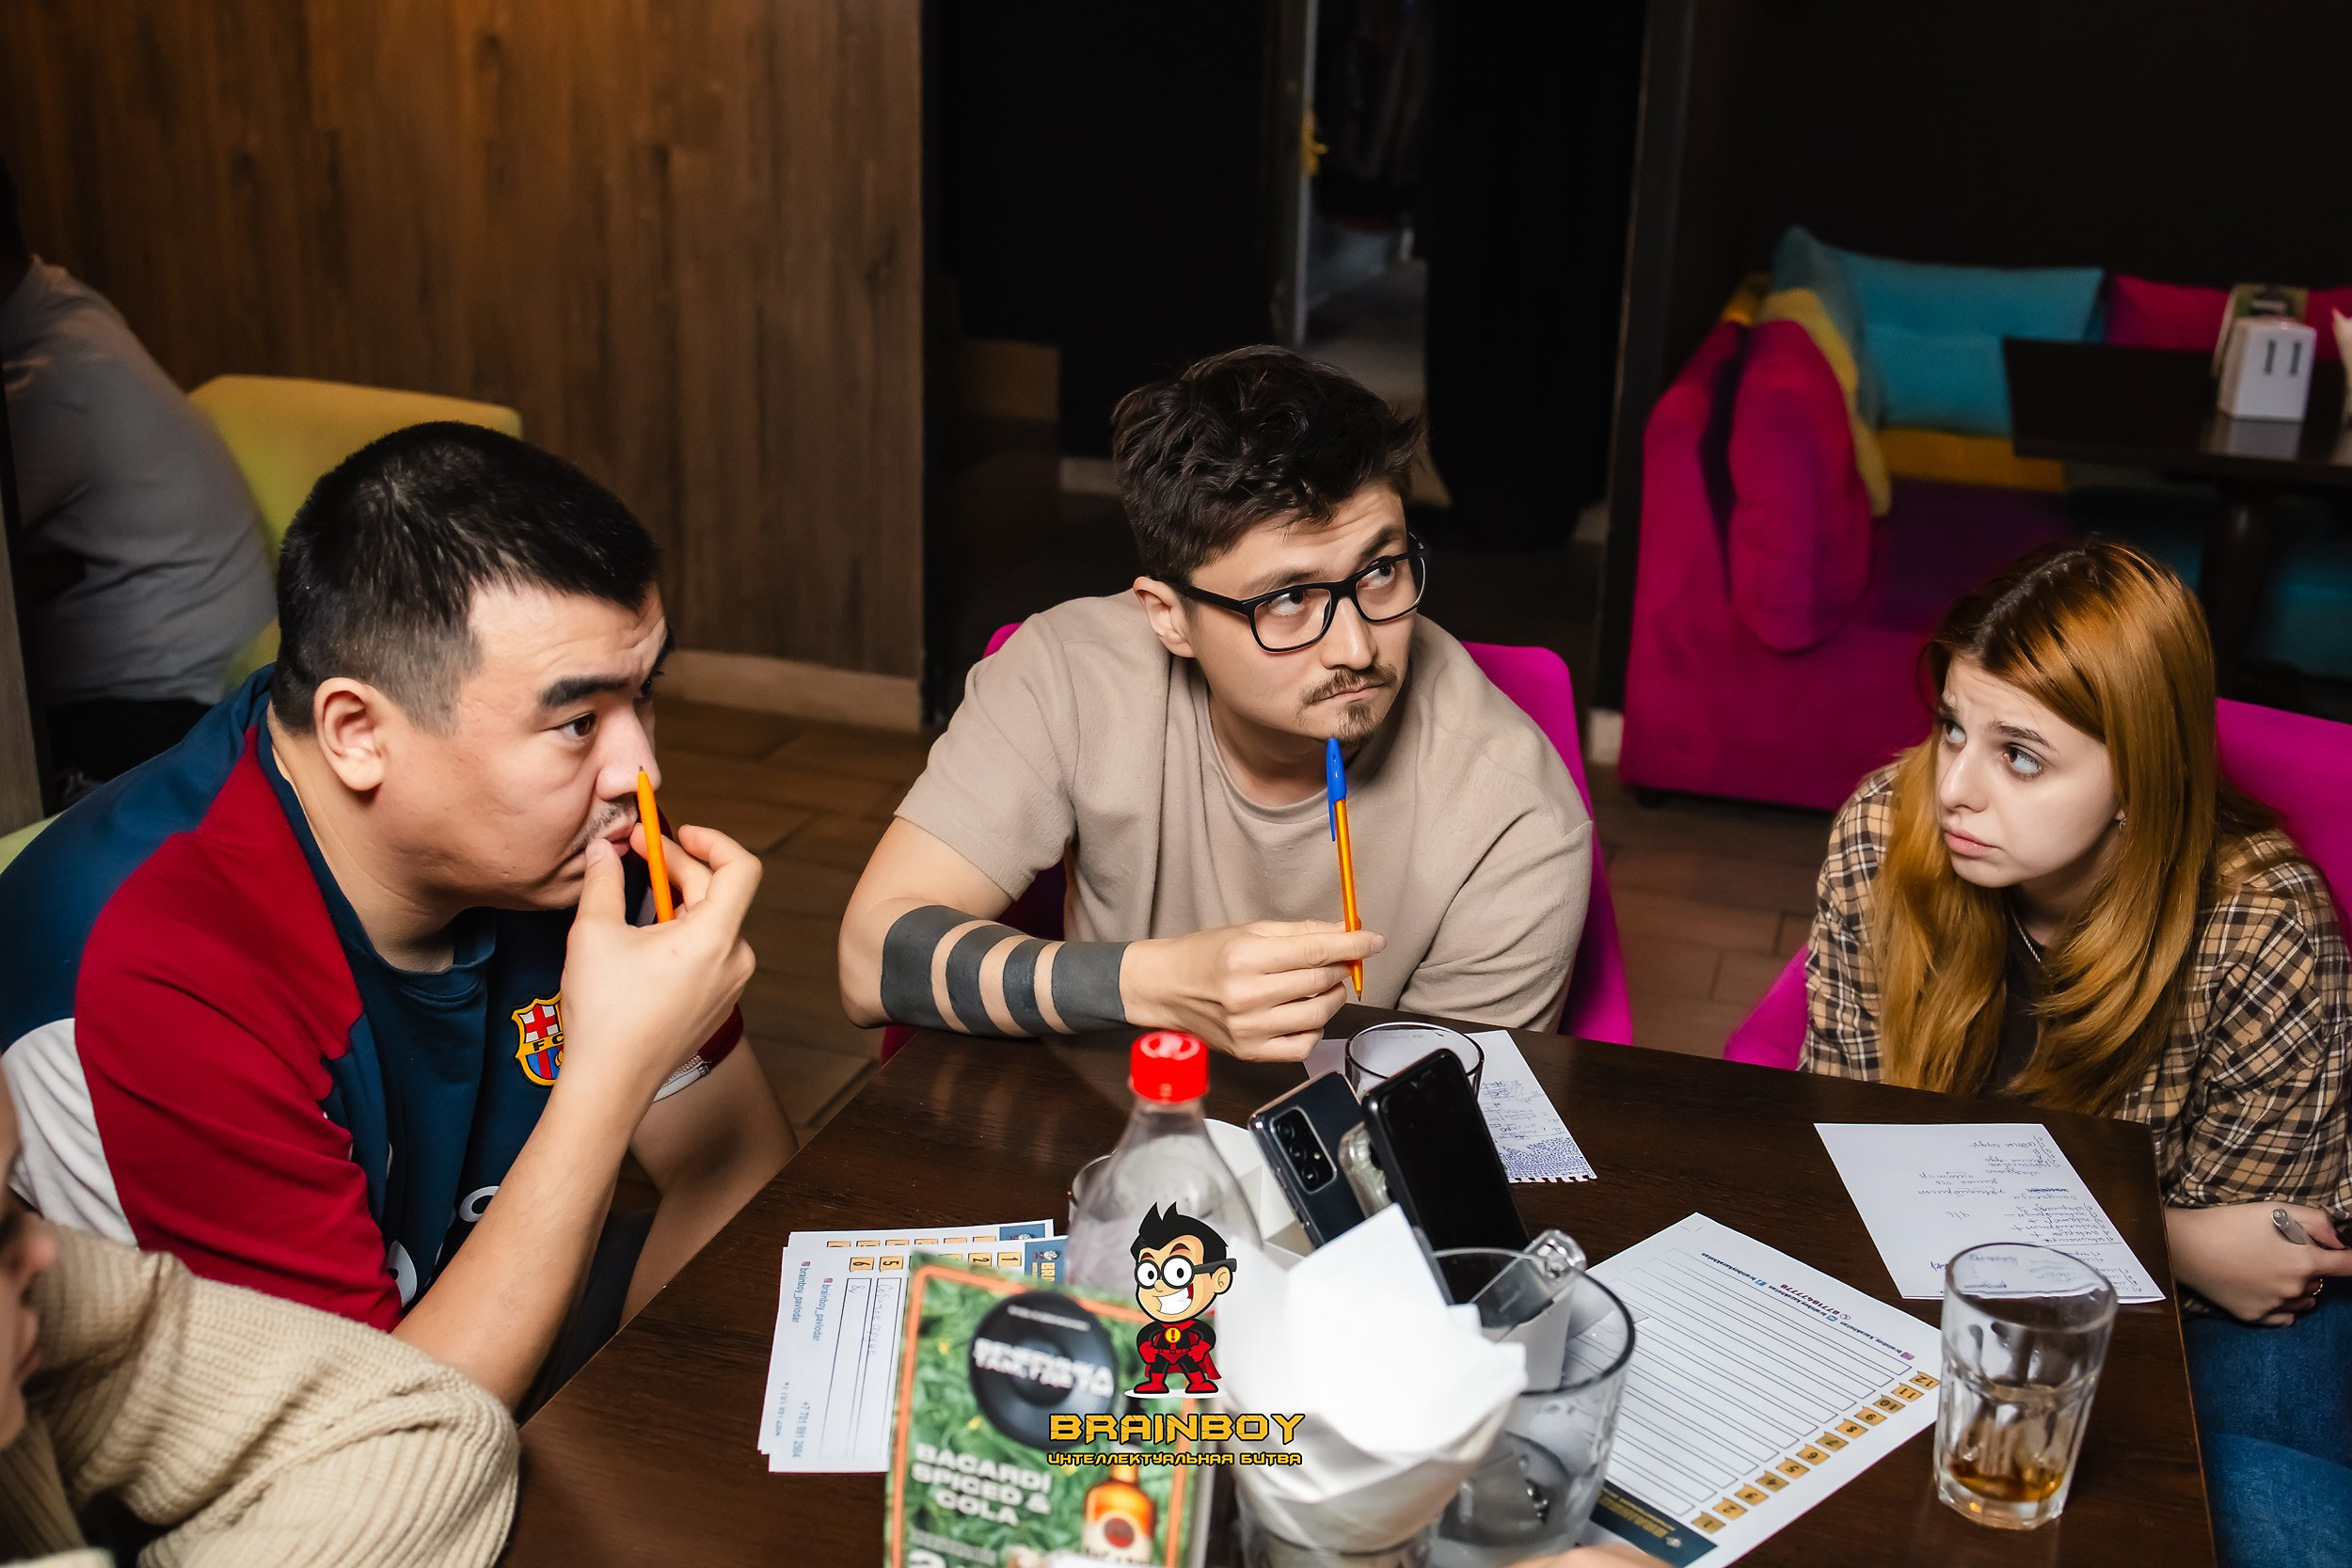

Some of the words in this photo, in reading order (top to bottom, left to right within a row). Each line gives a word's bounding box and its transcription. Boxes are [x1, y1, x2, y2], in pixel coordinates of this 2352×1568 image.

[2264, 339, 2302, 375] 11
[792, 1267, 809, 1323] brainboy_pavlodar
[813, 1284, 831, 1341] brainboy_pavlodar
[1899, 1387, 1916, 1399] 11
[1915, 1375, 1933, 1387] 12
[1880, 1399, 1898, 1411] 10
[911, 1464, 1024, 1507] SPICED
[934, 1488, 1021, 1528] COLA
